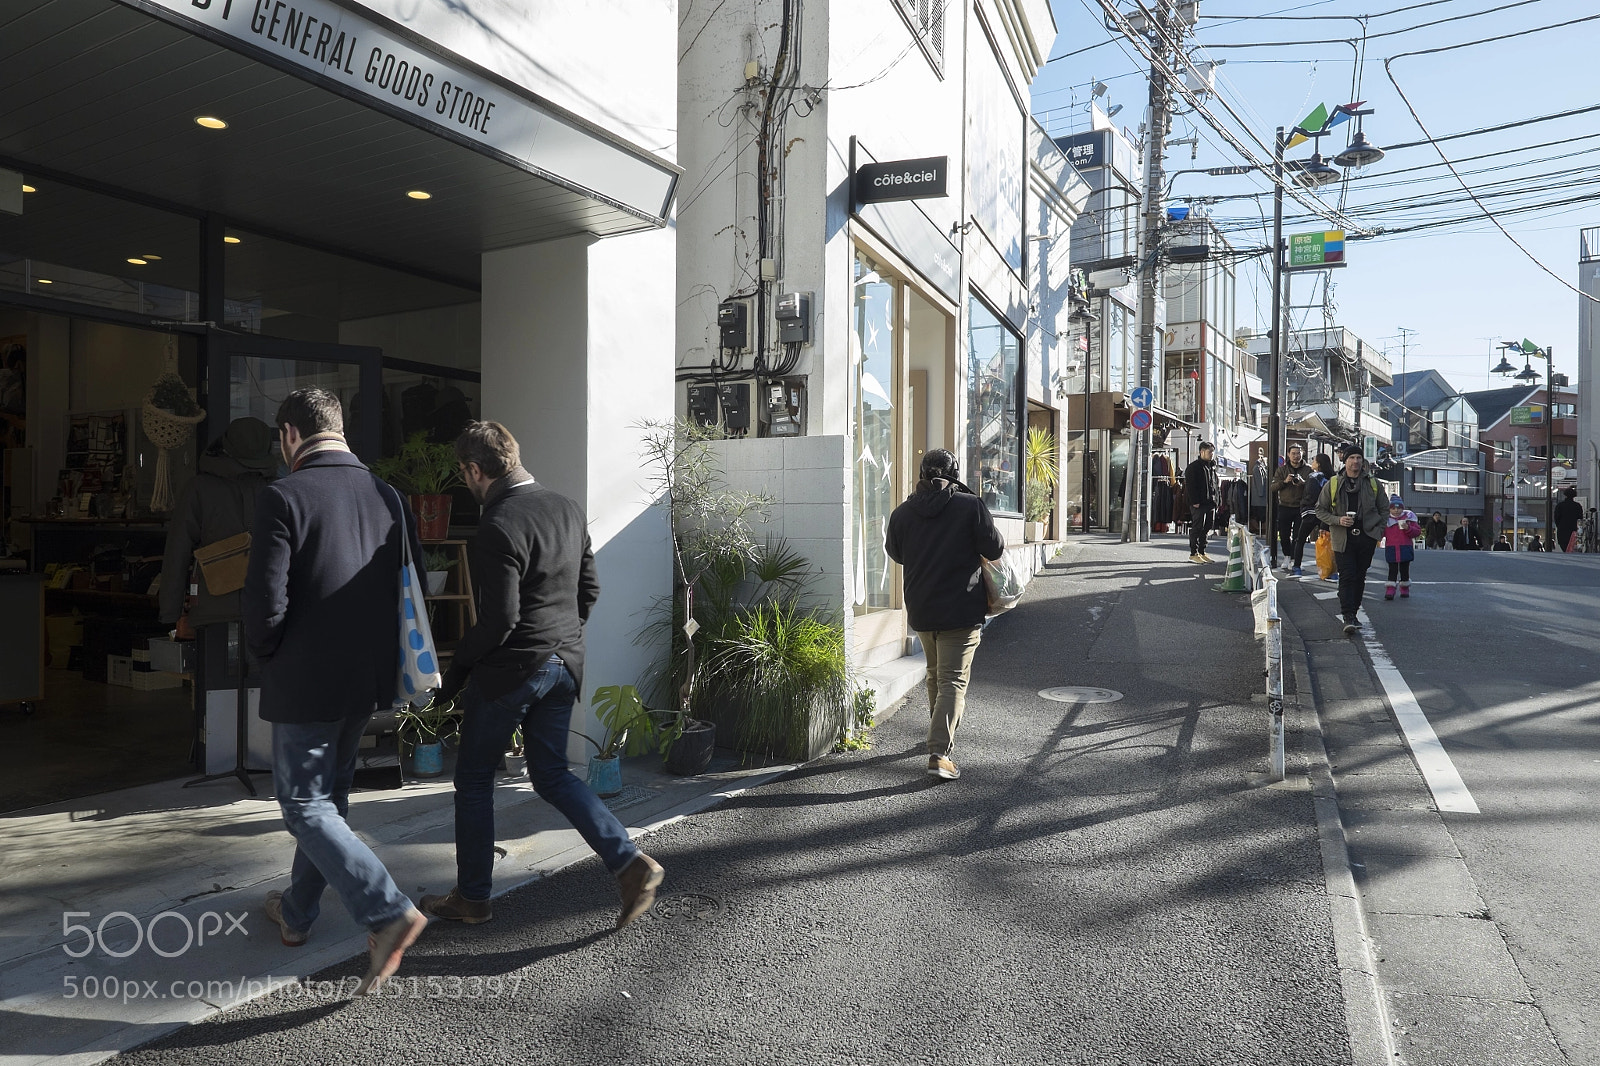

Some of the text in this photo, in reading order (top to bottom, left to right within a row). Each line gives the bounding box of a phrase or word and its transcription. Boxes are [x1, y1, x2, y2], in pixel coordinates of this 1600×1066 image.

[251, 0, 497, 134] GENERAL GOODS STORE
[874, 169, 937, 187] côte&ciel
[1294, 236, 1312, 244] 原宿
[1294, 244, 1321, 254] 神宮前
[1294, 254, 1321, 263] 商店会
